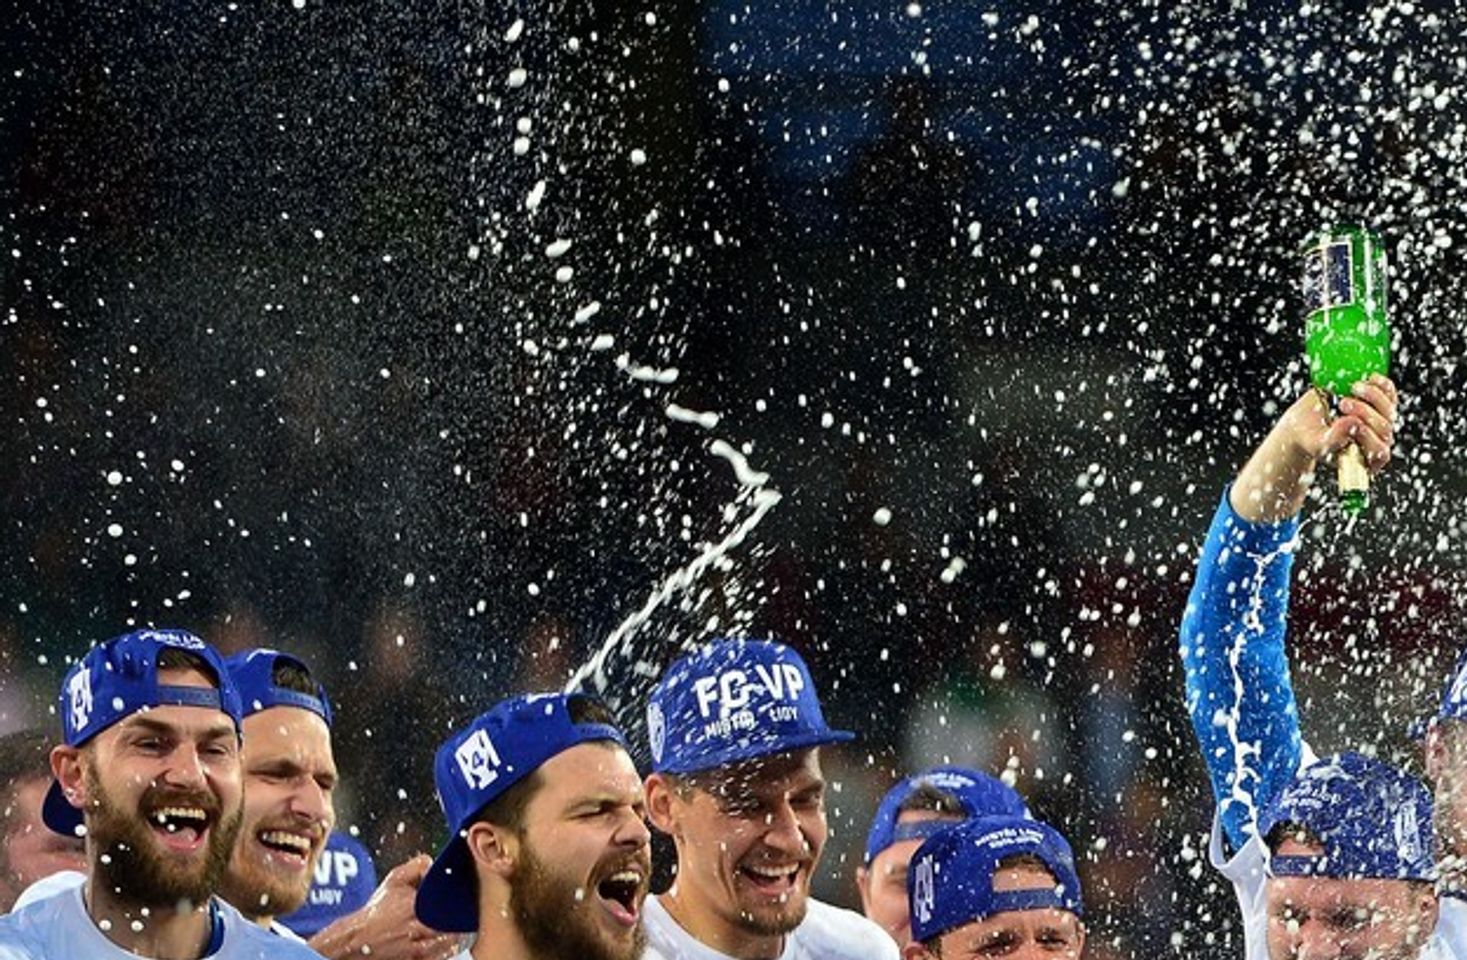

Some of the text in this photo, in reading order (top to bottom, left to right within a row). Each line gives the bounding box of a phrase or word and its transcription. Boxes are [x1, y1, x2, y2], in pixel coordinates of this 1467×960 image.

[695, 664, 804, 718] FC VP
[314, 849, 359, 887] VP
